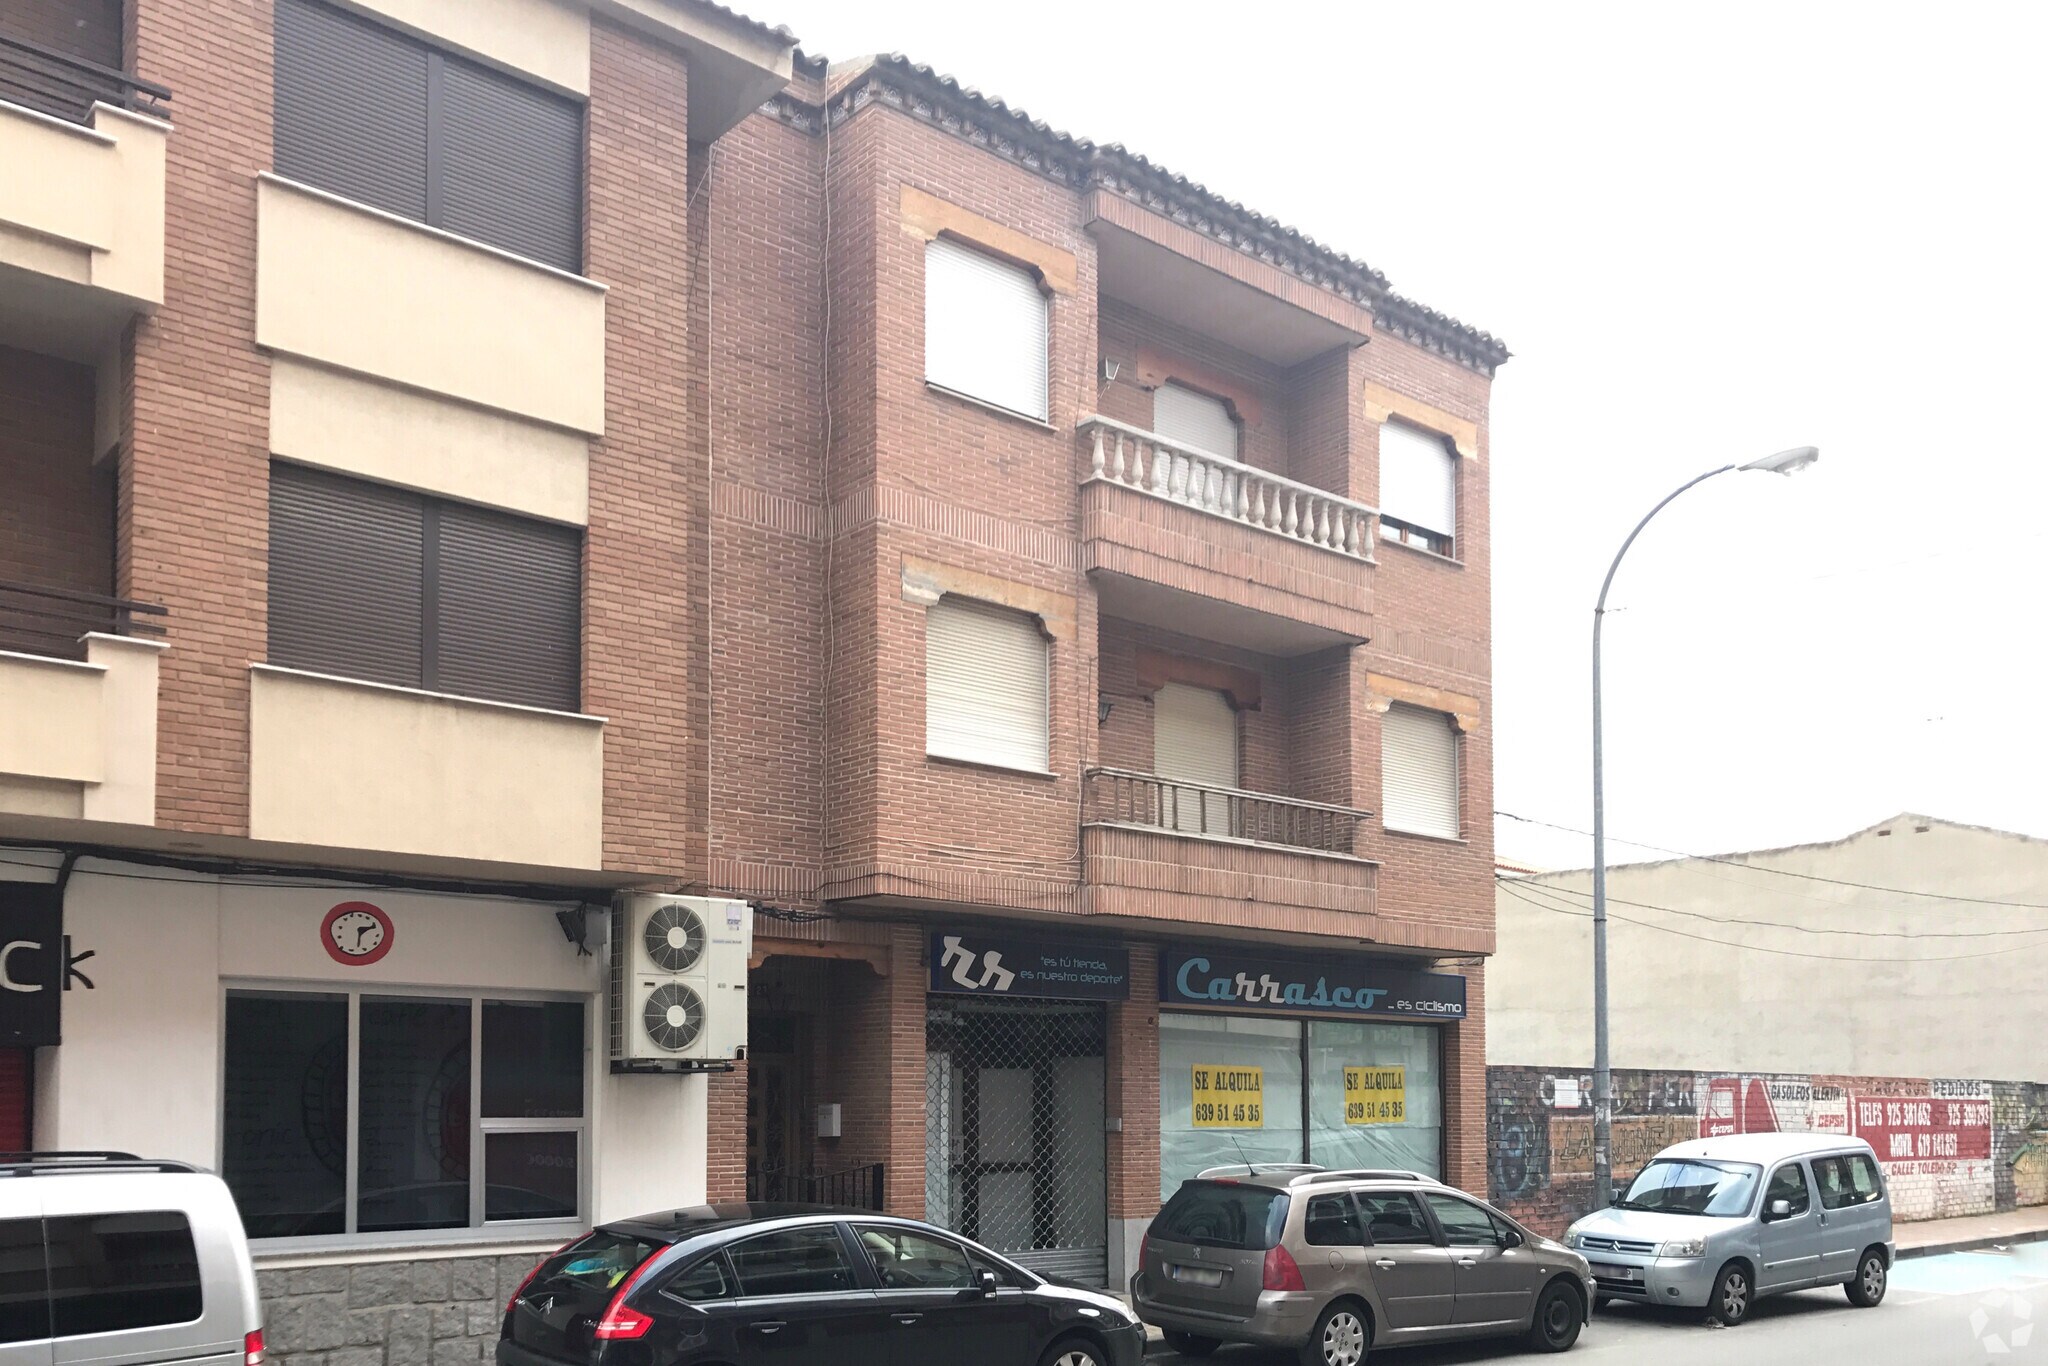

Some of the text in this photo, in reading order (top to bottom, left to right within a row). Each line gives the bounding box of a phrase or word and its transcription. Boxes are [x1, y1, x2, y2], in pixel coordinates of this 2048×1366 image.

[1020, 970, 1035, 979] es
[1037, 971, 1078, 982] nuestro
[1176, 957, 1388, 1010] Carrasco
[1397, 1000, 1412, 1010] es
[1416, 1000, 1462, 1013] ciclismo
[1195, 1071, 1260, 1092] SE ALQUILA
[1346, 1072, 1402, 1091] SE ALQUILA
[1933, 1081, 1981, 1097] PEDIDOS
[1196, 1103, 1260, 1122] 639 51 45 35
[1348, 1101, 1402, 1119] 639 51 45 35
[1859, 1102, 1883, 1127] TELFS
[1887, 1102, 1901, 1126] 925
[1891, 1163, 1915, 1176] CALLE
[1918, 1162, 1944, 1175] TOLEDO
